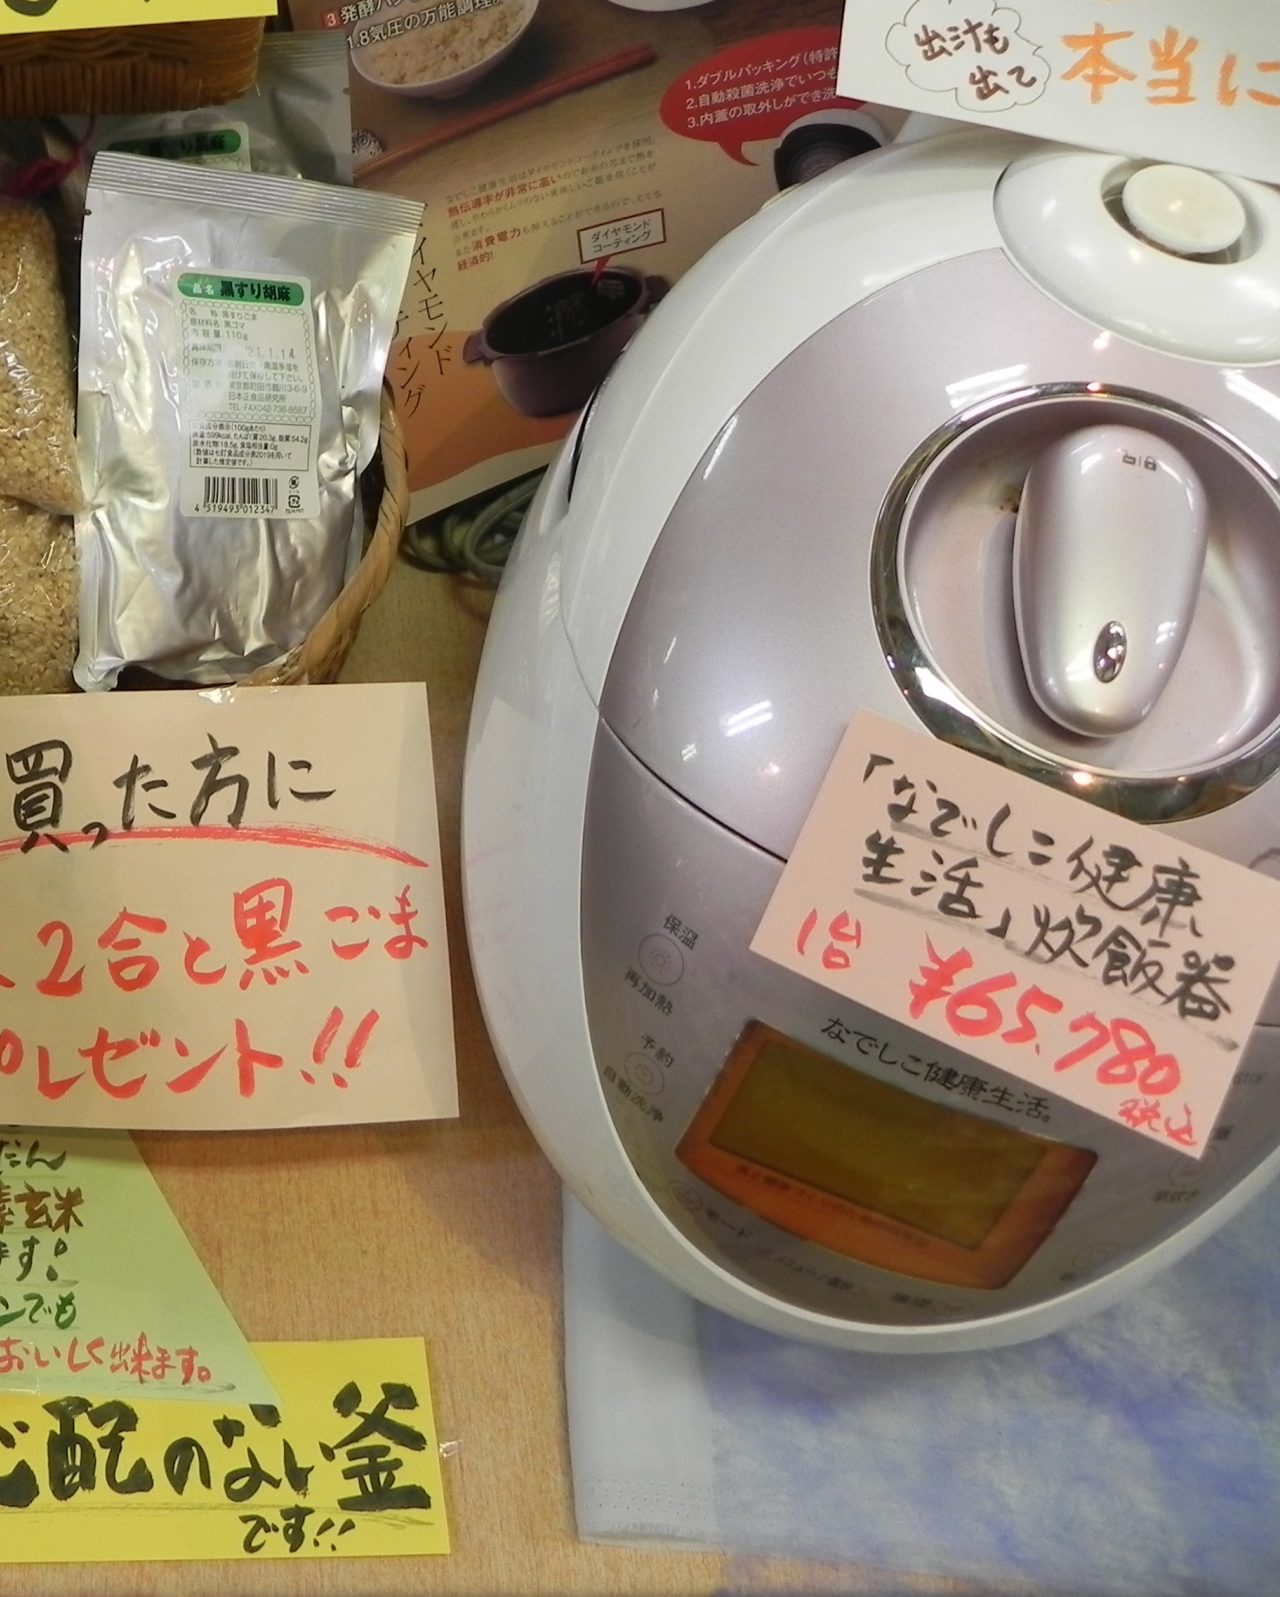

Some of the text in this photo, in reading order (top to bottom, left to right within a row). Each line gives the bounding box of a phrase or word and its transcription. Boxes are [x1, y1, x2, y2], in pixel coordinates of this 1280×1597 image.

[968, 63, 1038, 102] 出て
[1059, 21, 1280, 106] 本当に
[591, 218, 652, 243] ダイヤモンド
[593, 230, 652, 254] コーティング
[220, 280, 291, 302] 黒すり胡麻
[412, 204, 452, 375] イヤモンド
[663, 914, 699, 950] 保温
[860, 829, 1238, 1022] 生活」炊飯器
[795, 906, 863, 971] 1台
[1118, 1095, 1199, 1147] 税込
[641, 1032, 674, 1069] 予約
[821, 1016, 1052, 1124] なでしこ健康生活。
